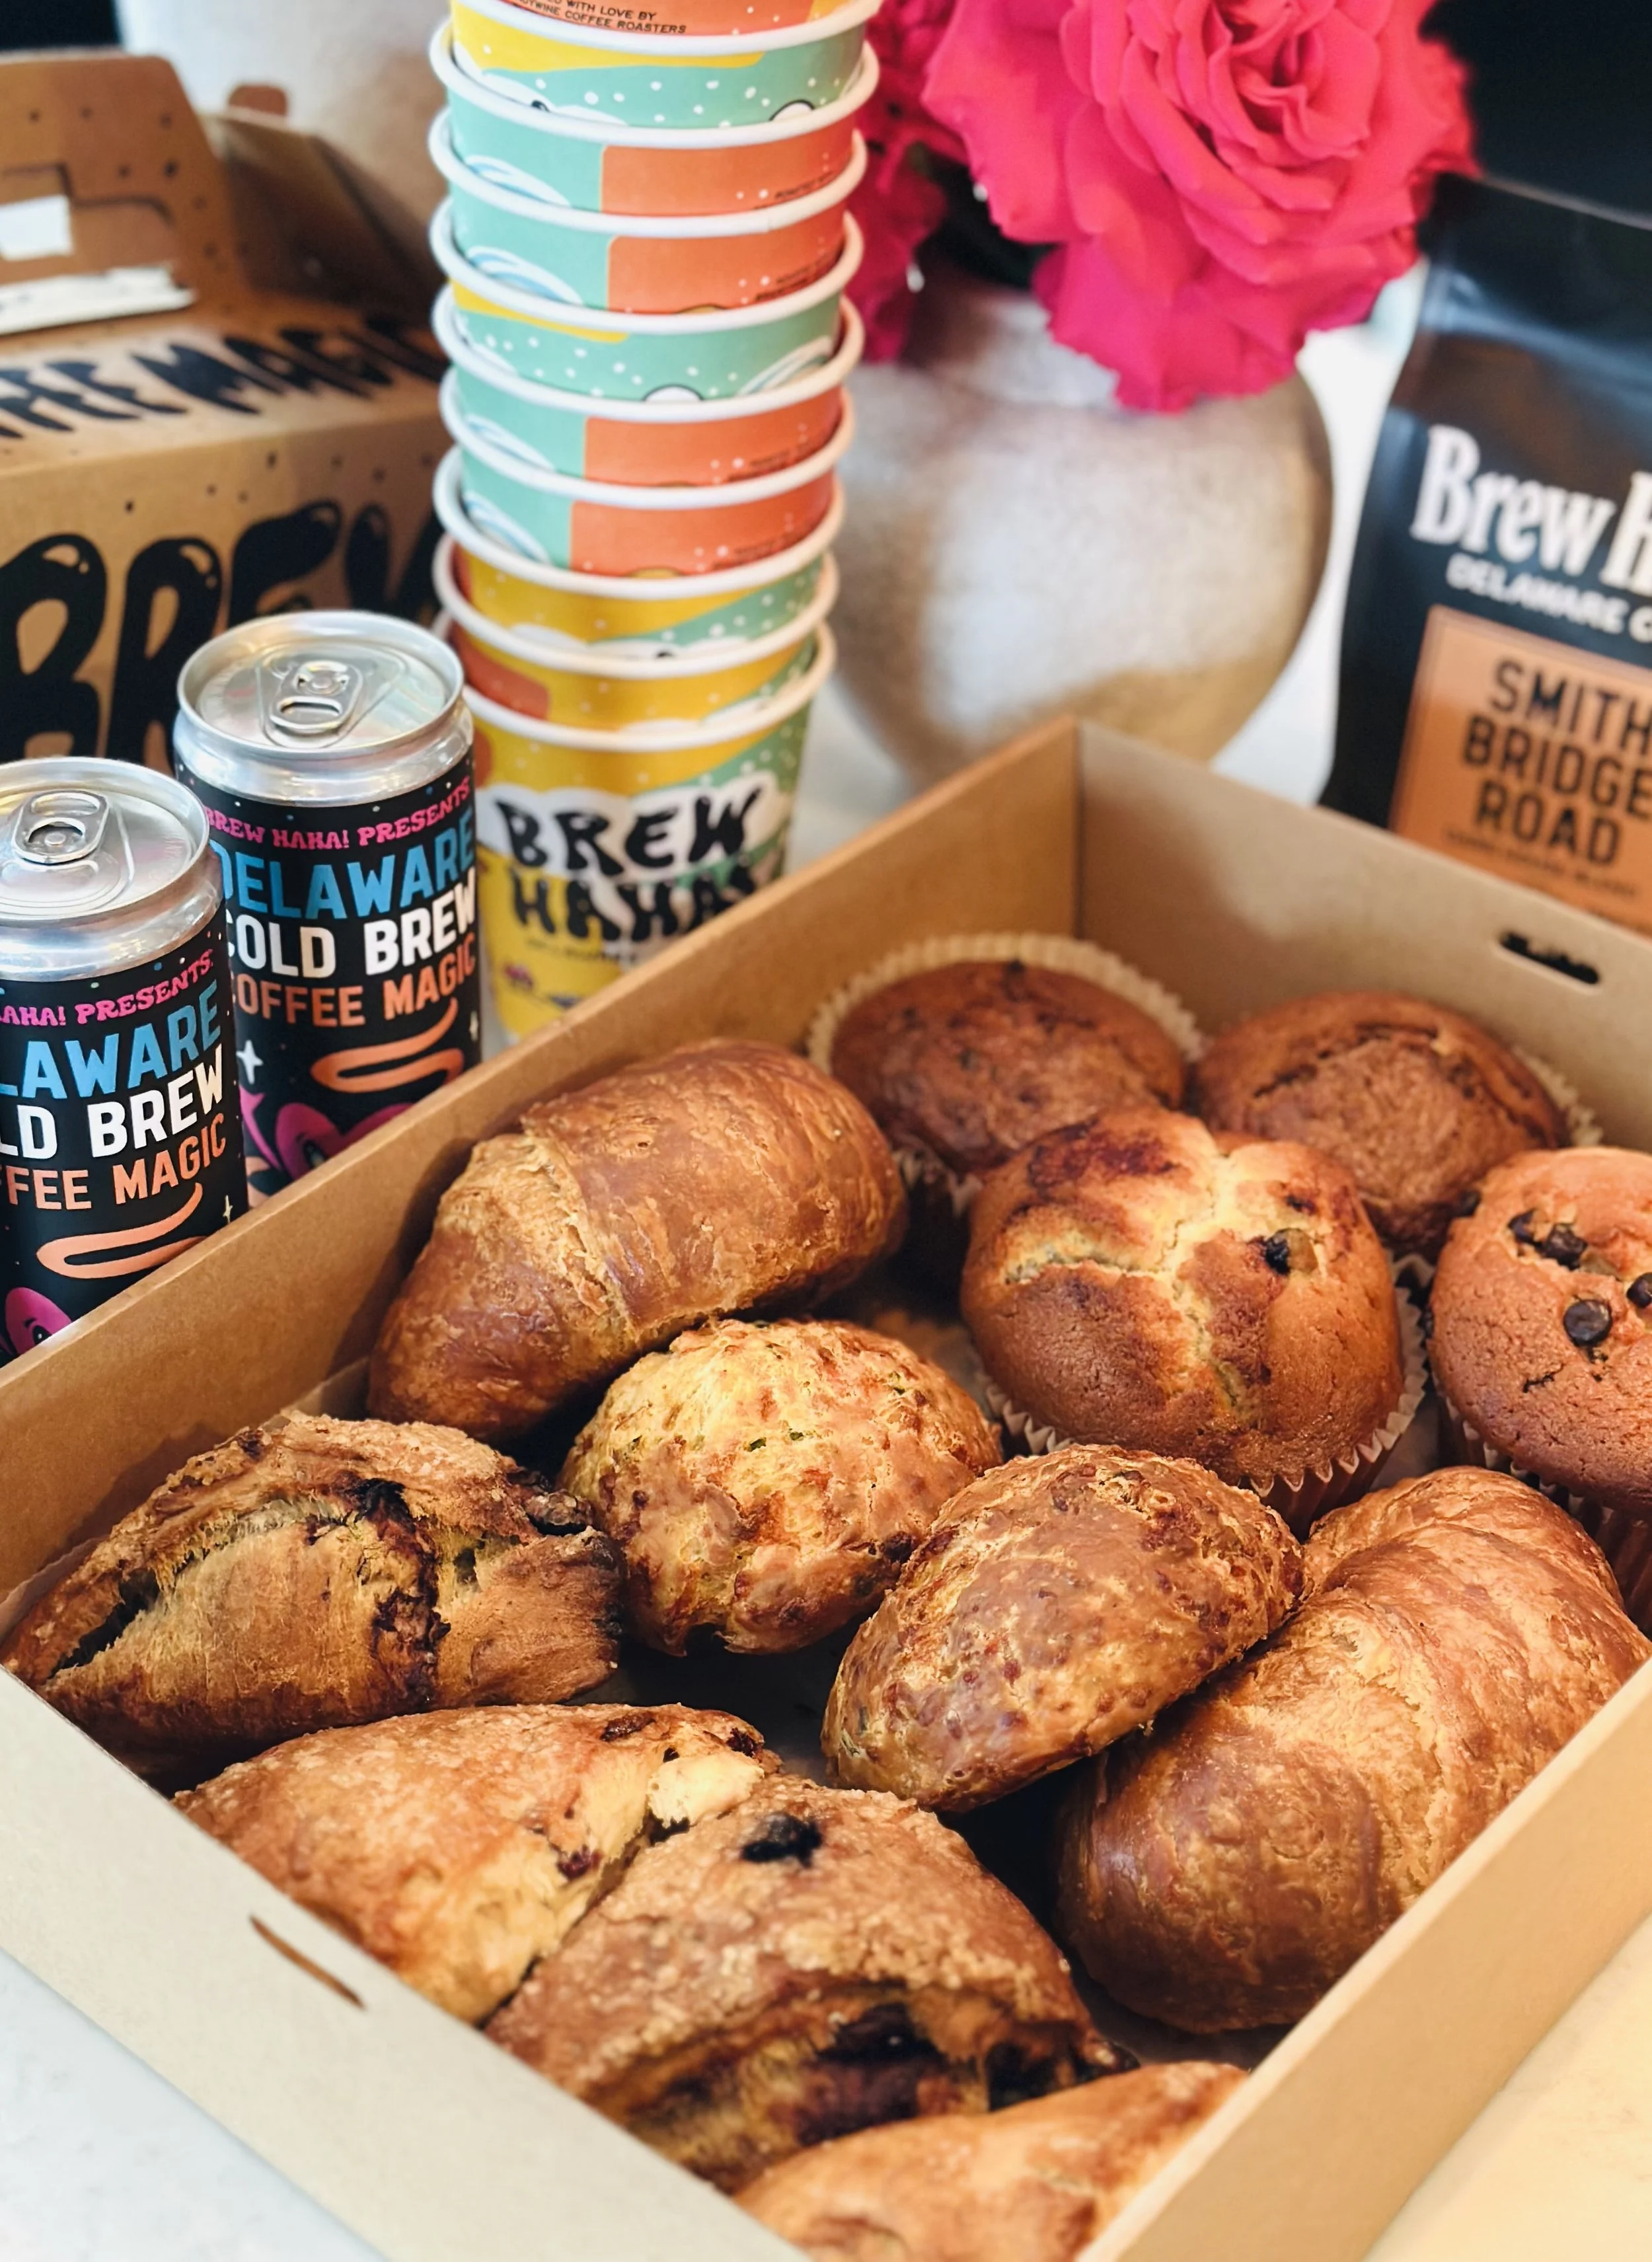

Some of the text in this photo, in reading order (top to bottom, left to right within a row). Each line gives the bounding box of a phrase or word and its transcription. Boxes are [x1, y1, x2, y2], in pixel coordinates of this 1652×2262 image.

[565, 11, 611, 27] COFFEE
[617, 20, 687, 34] ROASTERS
[600, 7, 632, 19] LOVE
[638, 11, 657, 21] BY
[1410, 424, 1616, 577] Brew
[1491, 659, 1652, 757] SMITH
[272, 829, 350, 850] HAHA!
[357, 776, 471, 847] PRESENTS
[1464, 715, 1652, 819] BRIDGE
[494, 784, 767, 876] BREW
[1475, 780, 1622, 868] ROAD
[226, 867, 476, 979] OLD BREW
[0, 948, 213, 1026] AHA! PRESENTS
[231, 932, 476, 1028] OFFEE MAGIC
[87, 1043, 223, 1158] BREW
[112, 1112, 227, 1205] MAGIC
